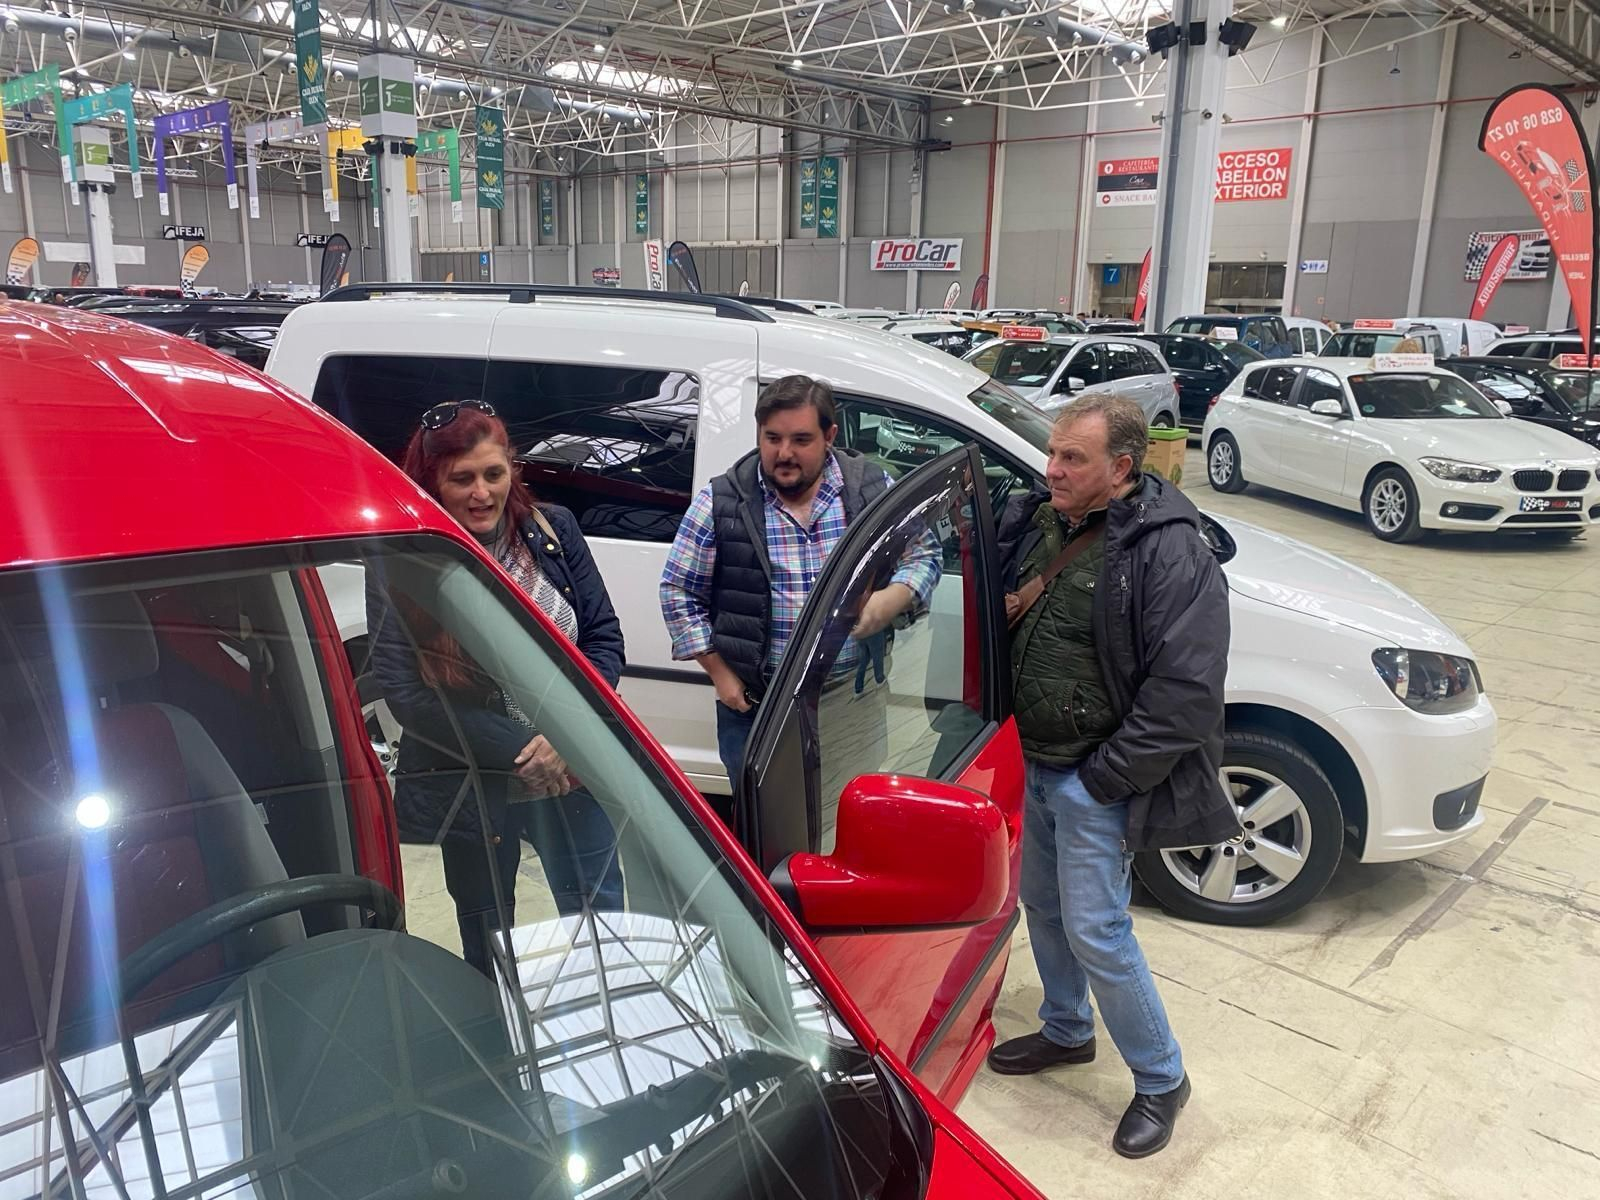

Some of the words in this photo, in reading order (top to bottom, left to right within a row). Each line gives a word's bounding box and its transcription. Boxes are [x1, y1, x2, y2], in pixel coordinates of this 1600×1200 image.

[1215, 184, 1282, 199] XTERIOR
[175, 226, 204, 237] IFEJA
[307, 234, 330, 244] IFEJ
[878, 240, 958, 262] ProCar
[482, 254, 488, 264] 3
[1108, 268, 1118, 281] 7
